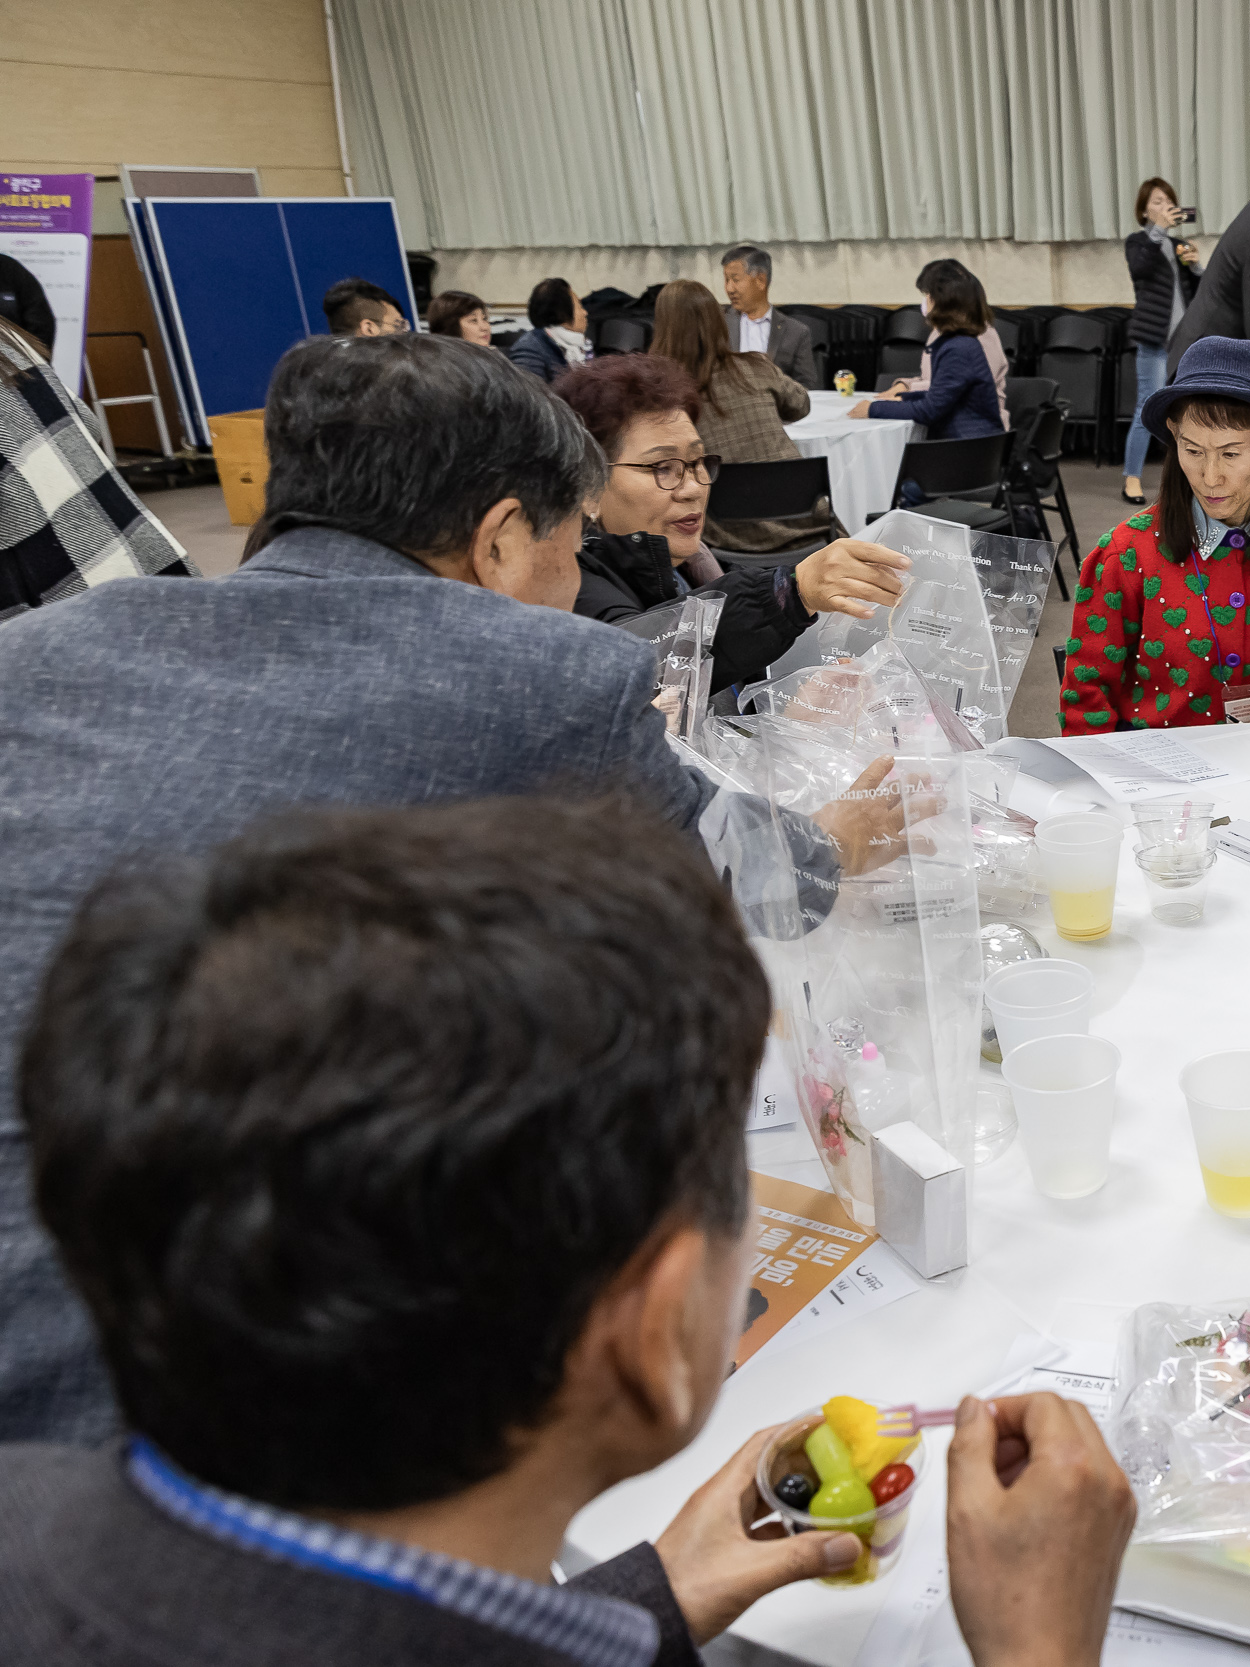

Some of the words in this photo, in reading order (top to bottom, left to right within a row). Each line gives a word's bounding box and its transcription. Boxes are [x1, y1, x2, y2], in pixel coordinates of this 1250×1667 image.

[902, 545, 930, 556] Flower
[946, 552, 992, 566] Decoration
[1009, 562, 1031, 572] Thank
[1032, 565, 1045, 573] for
[912, 607, 933, 617] Thank
[935, 611, 946, 621] for
[947, 615, 963, 624] you
[980, 620, 1004, 635] Happy
[1005, 626, 1016, 634] to
[1016, 627, 1029, 636] you
[980, 683, 1002, 693] Happy
[793, 696, 841, 716] Decoration
[756, 1222, 793, 1251] 을
[785, 1234, 851, 1267] 만든
